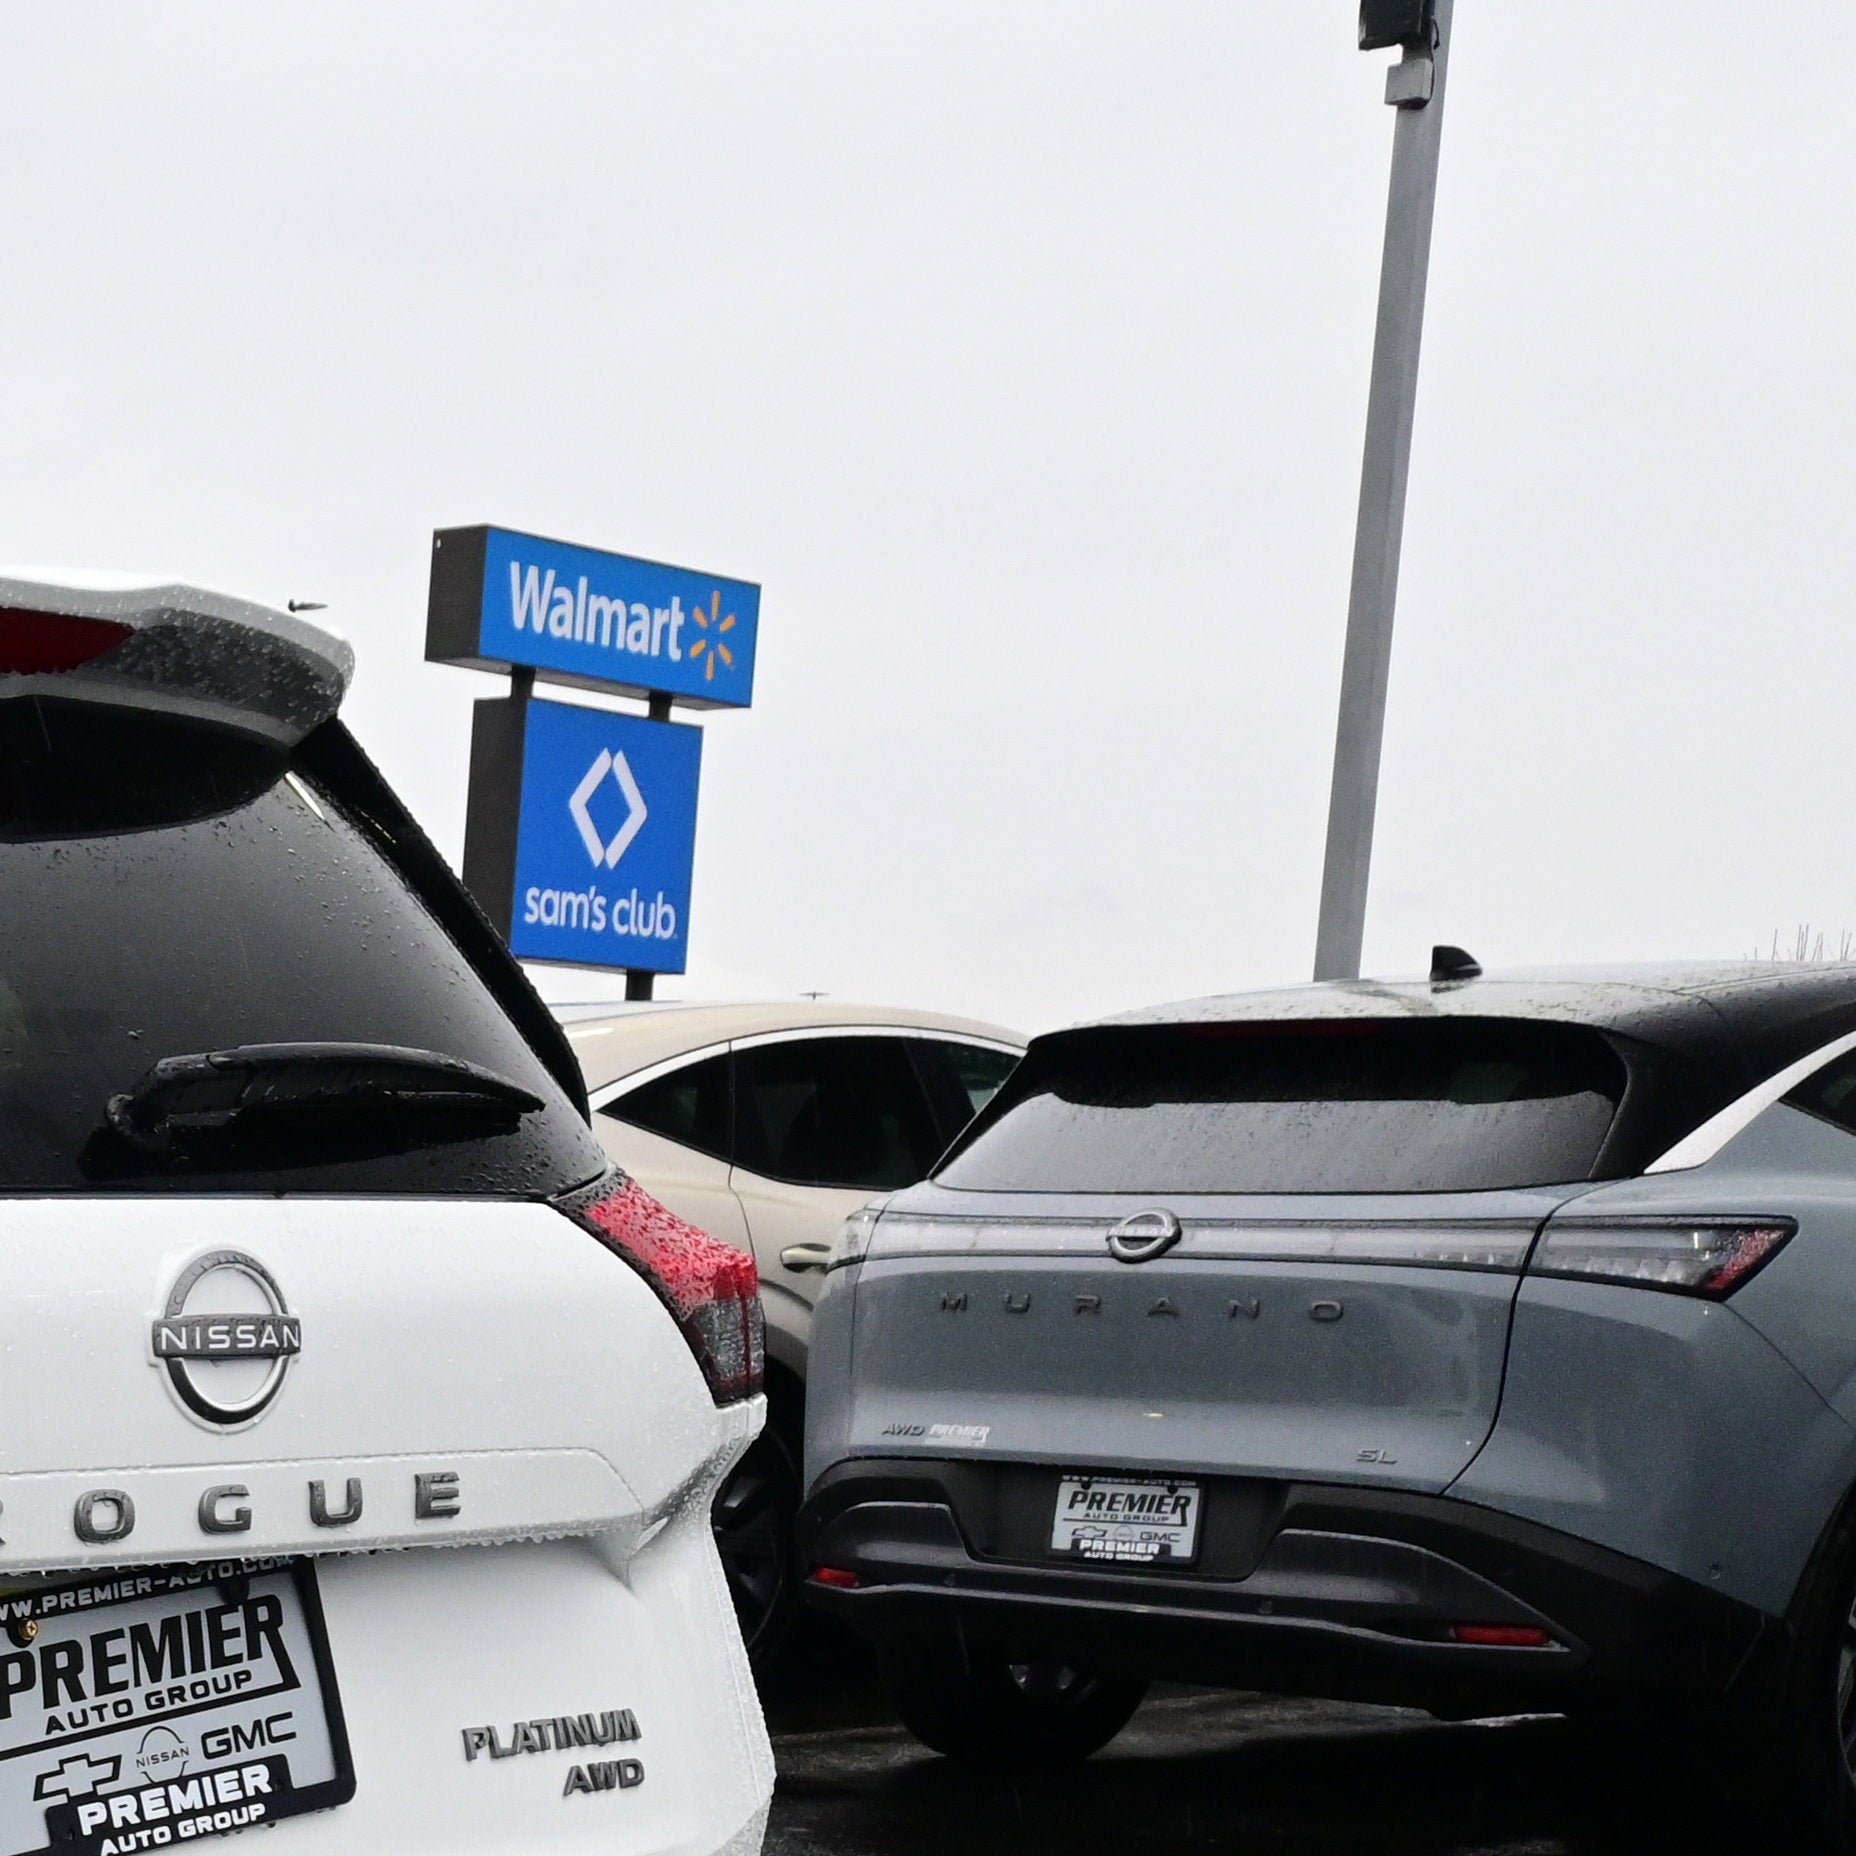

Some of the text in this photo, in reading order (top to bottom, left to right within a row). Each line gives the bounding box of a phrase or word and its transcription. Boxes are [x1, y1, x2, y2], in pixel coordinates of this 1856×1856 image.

[510, 561, 684, 661] Walmart
[524, 886, 675, 938] sam's club
[939, 1292, 1344, 1322] MURANO
[161, 1323, 300, 1349] NISSAN
[881, 1423, 926, 1437] AWD
[1356, 1447, 1397, 1465] SL
[1068, 1490, 1191, 1526] PREMIER
[1084, 1512, 1170, 1522] AUTO GROUP
[1079, 1538, 1160, 1554] PREMIER
[1140, 1531, 1181, 1543] GMC
[1084, 1551, 1154, 1562] AUTO GROUP
[45, 1669, 252, 1735] AUTO GROUP
[201, 1712, 296, 1760] GMC
[462, 1708, 642, 1762] PLATINUM
[135, 1746, 190, 1769] NISSAN
[563, 1758, 645, 1797] AWD
[77, 1763, 272, 1837] PREMIER
[100, 1803, 266, 1856] AUTO GROUP
